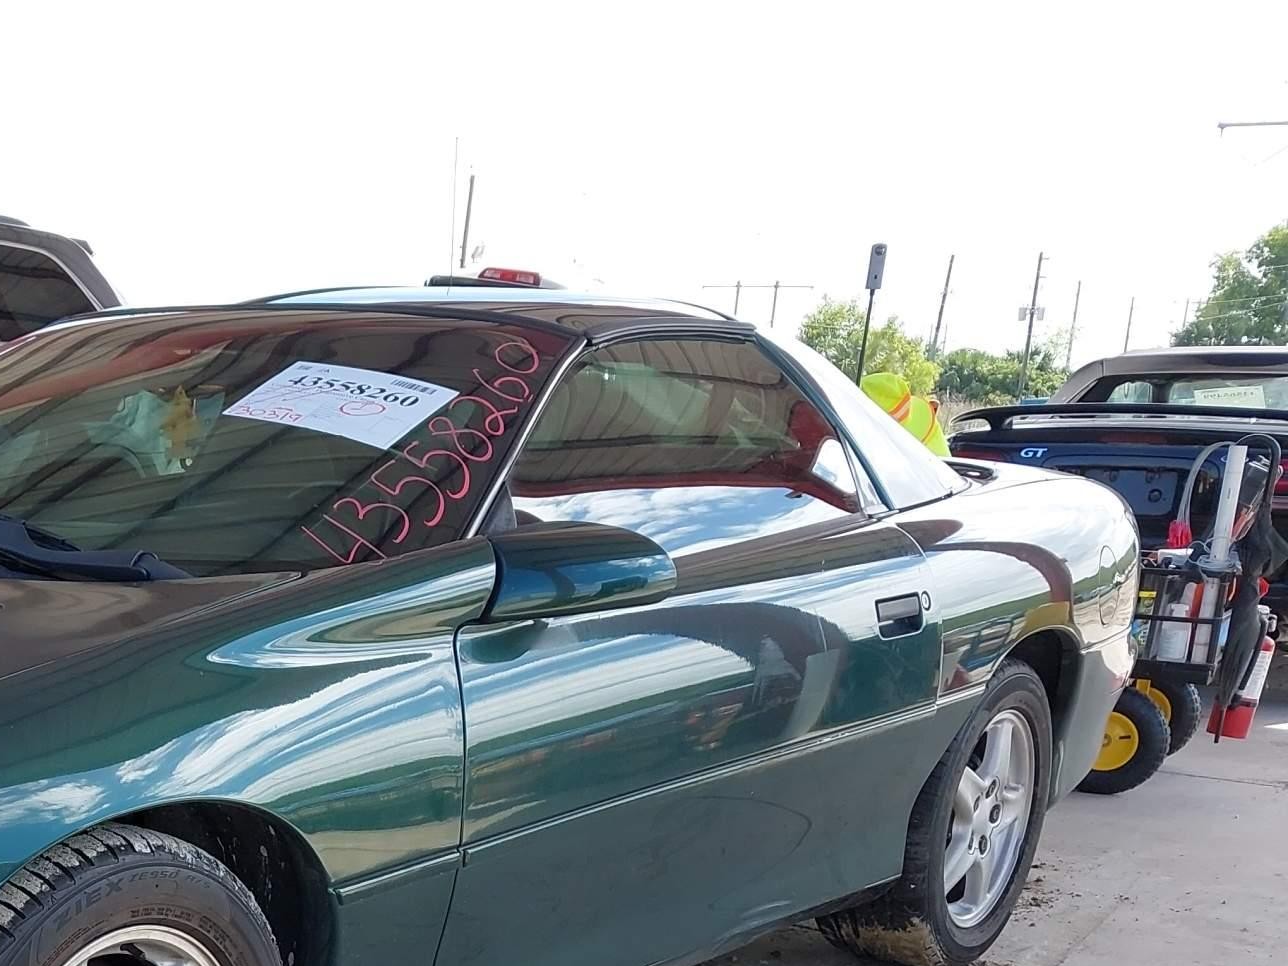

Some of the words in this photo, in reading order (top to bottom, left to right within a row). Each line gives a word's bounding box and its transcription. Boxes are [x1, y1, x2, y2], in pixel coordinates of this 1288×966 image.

[288, 375, 420, 408] 43558260
[301, 337, 540, 564] 43558260
[1020, 447, 1048, 458] GT
